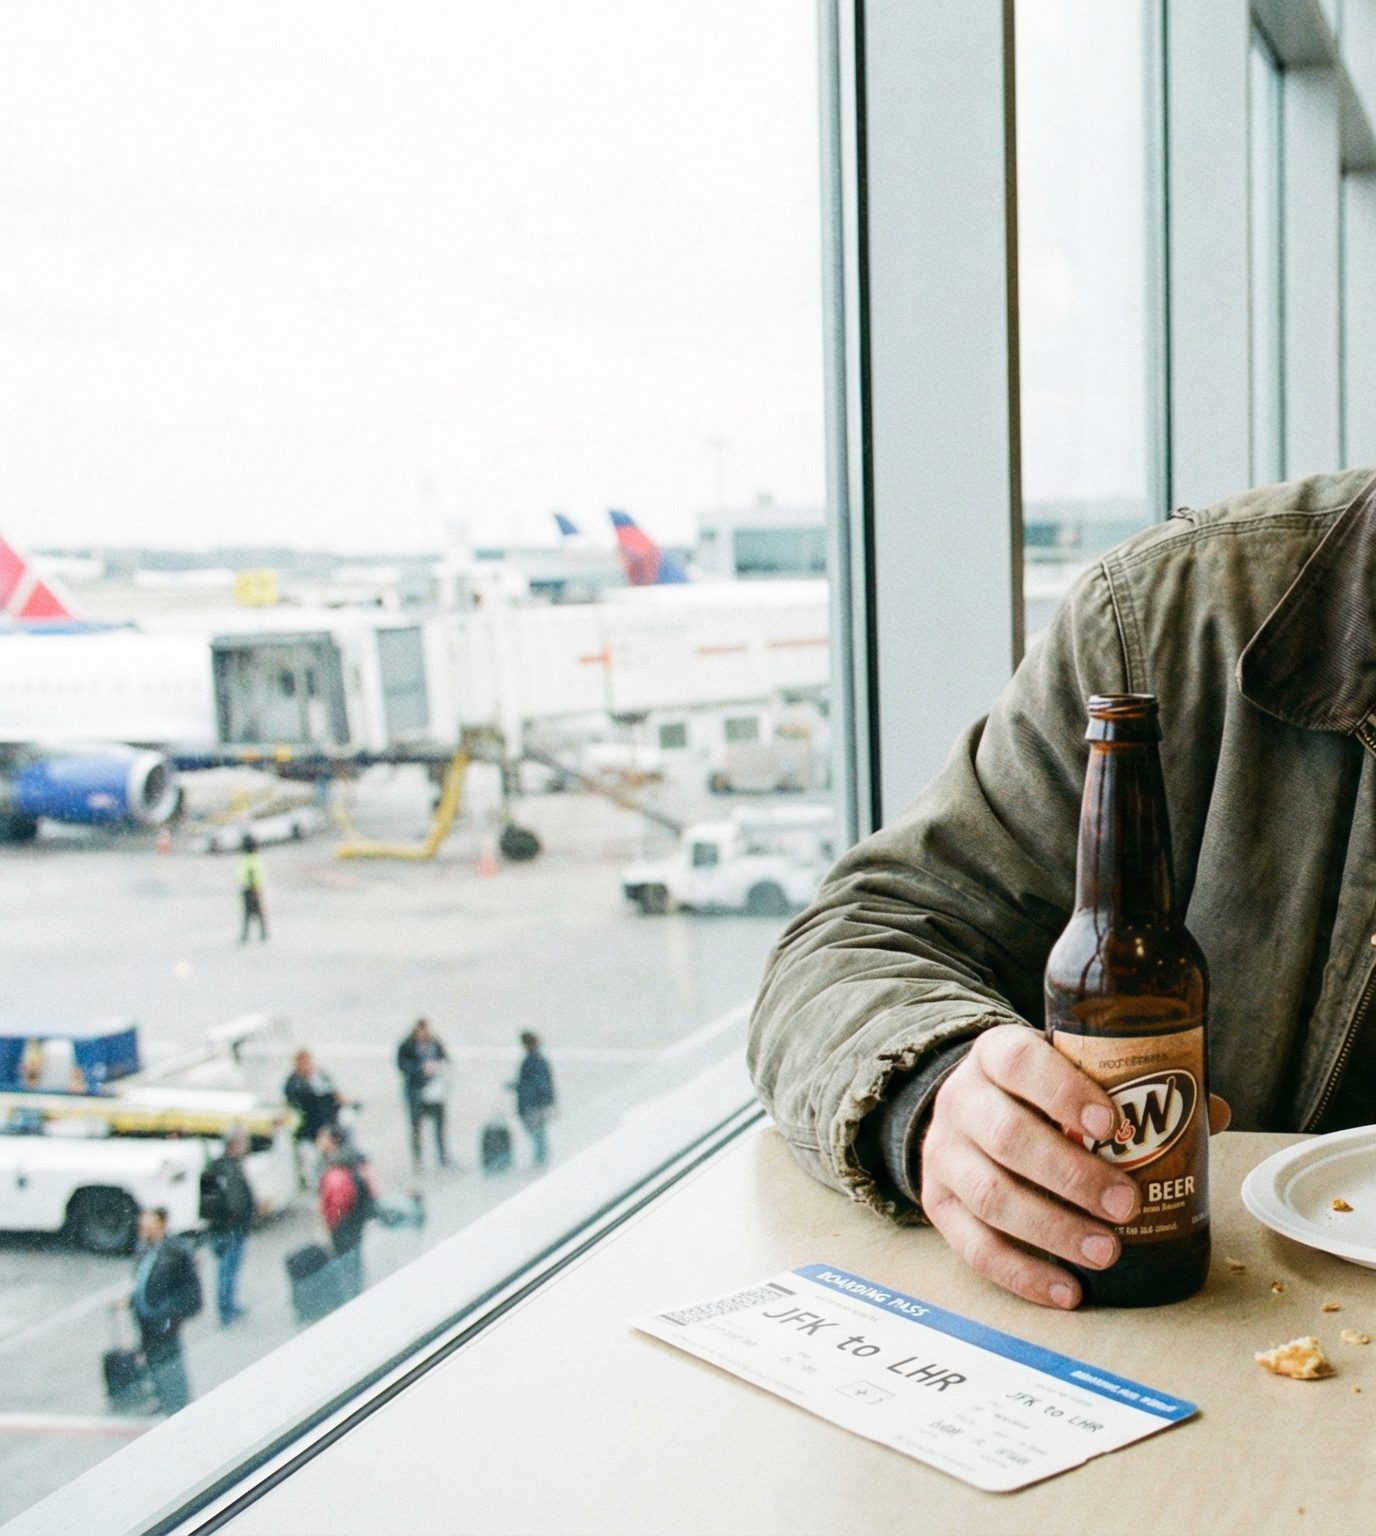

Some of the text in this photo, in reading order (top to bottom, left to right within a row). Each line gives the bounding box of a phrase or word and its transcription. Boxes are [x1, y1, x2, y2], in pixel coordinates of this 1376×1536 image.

[1148, 1175, 1195, 1202] BEER
[816, 1270, 891, 1303] BOARDING
[887, 1298, 930, 1317] PASS
[762, 1307, 839, 1336] JFK
[836, 1335, 881, 1357] to
[886, 1356, 967, 1392] LHR
[1005, 1392, 1042, 1408] JFK
[1067, 1415, 1105, 1433] LHR
